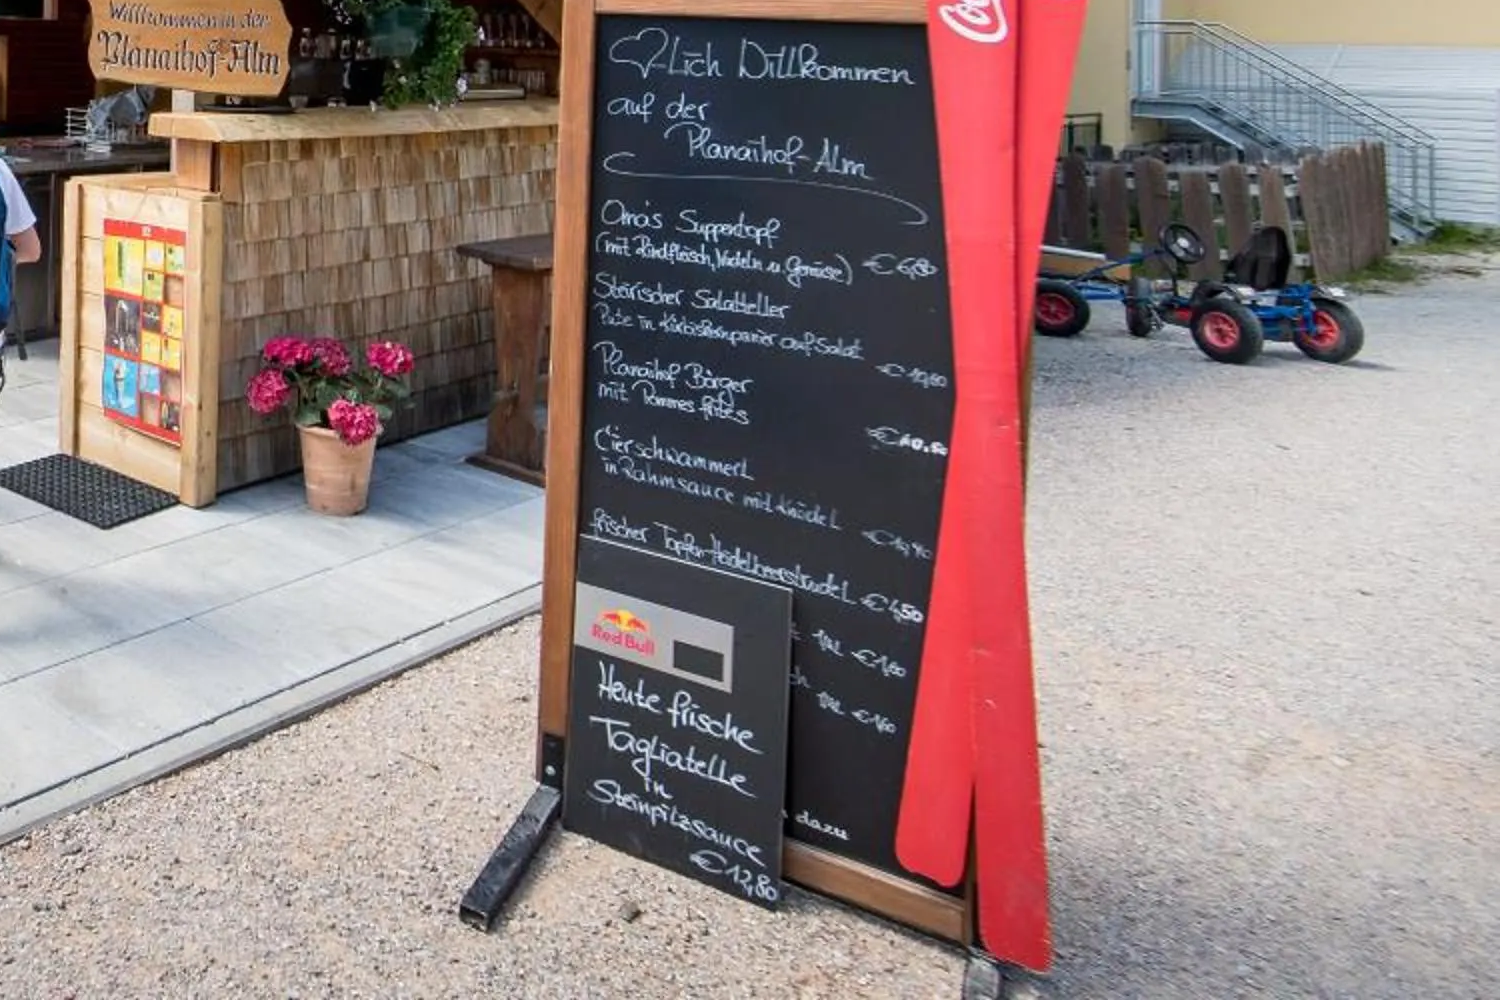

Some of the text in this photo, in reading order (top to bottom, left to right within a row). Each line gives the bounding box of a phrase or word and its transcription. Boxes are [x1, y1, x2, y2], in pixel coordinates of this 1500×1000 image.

[109, 0, 216, 29] Willkommen
[239, 8, 272, 30] der
[97, 29, 280, 78] Planaihof-Alm
[606, 92, 712, 123] auf der
[601, 199, 781, 249] Oma's Suppentopf
[593, 272, 791, 319] Steirischer Salatteller
[637, 314, 657, 331] in
[814, 337, 865, 361] Salat
[597, 381, 629, 402] mit
[631, 379, 696, 413] Pommes
[601, 456, 619, 475] in
[617, 455, 735, 505] Rahmsauce
[591, 622, 656, 657] Red Bull
[597, 660, 764, 755] Heute frische
[588, 715, 758, 799] Tagliatelle
[643, 776, 674, 801] in
[586, 778, 768, 868] Steinpilzsauce
[795, 809, 851, 841] dazu
